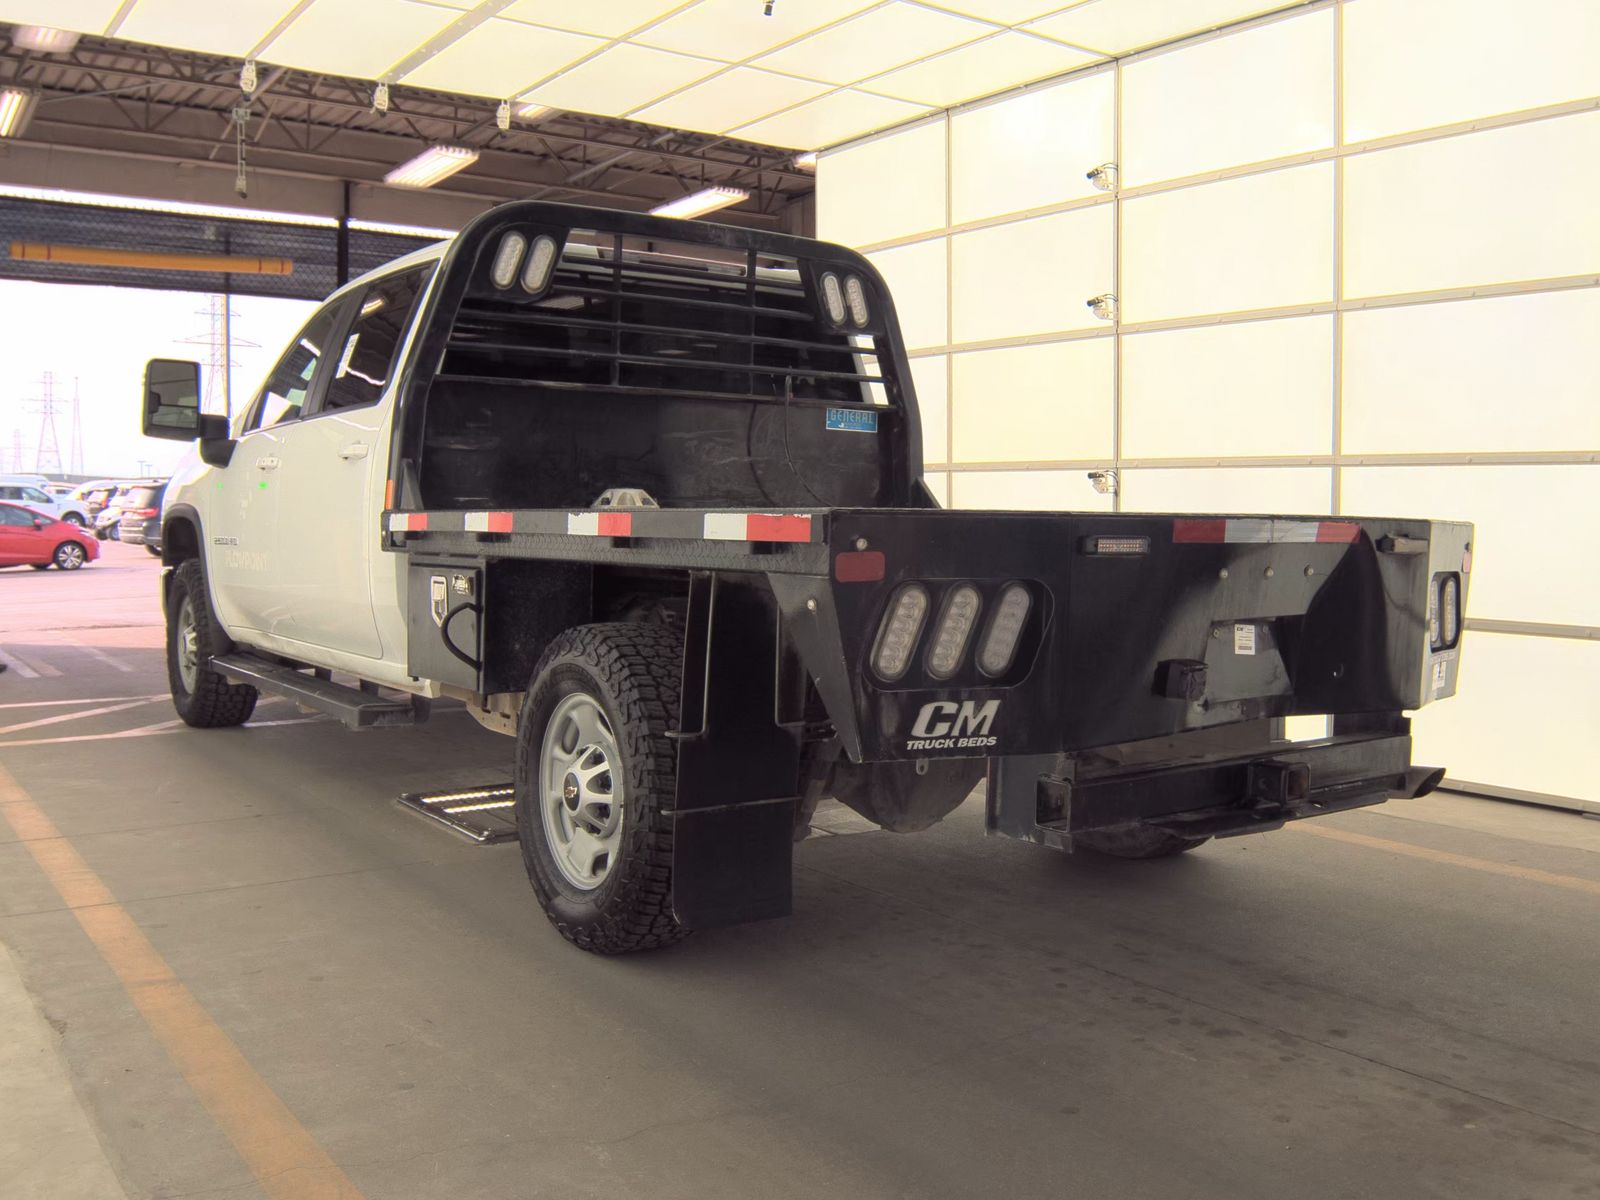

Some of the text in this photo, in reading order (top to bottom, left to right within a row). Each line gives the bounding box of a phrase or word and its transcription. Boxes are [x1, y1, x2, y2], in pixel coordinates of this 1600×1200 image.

[830, 409, 874, 424] GENERAL
[911, 700, 1001, 738] CM
[906, 736, 998, 750] TRUCK BEDS
